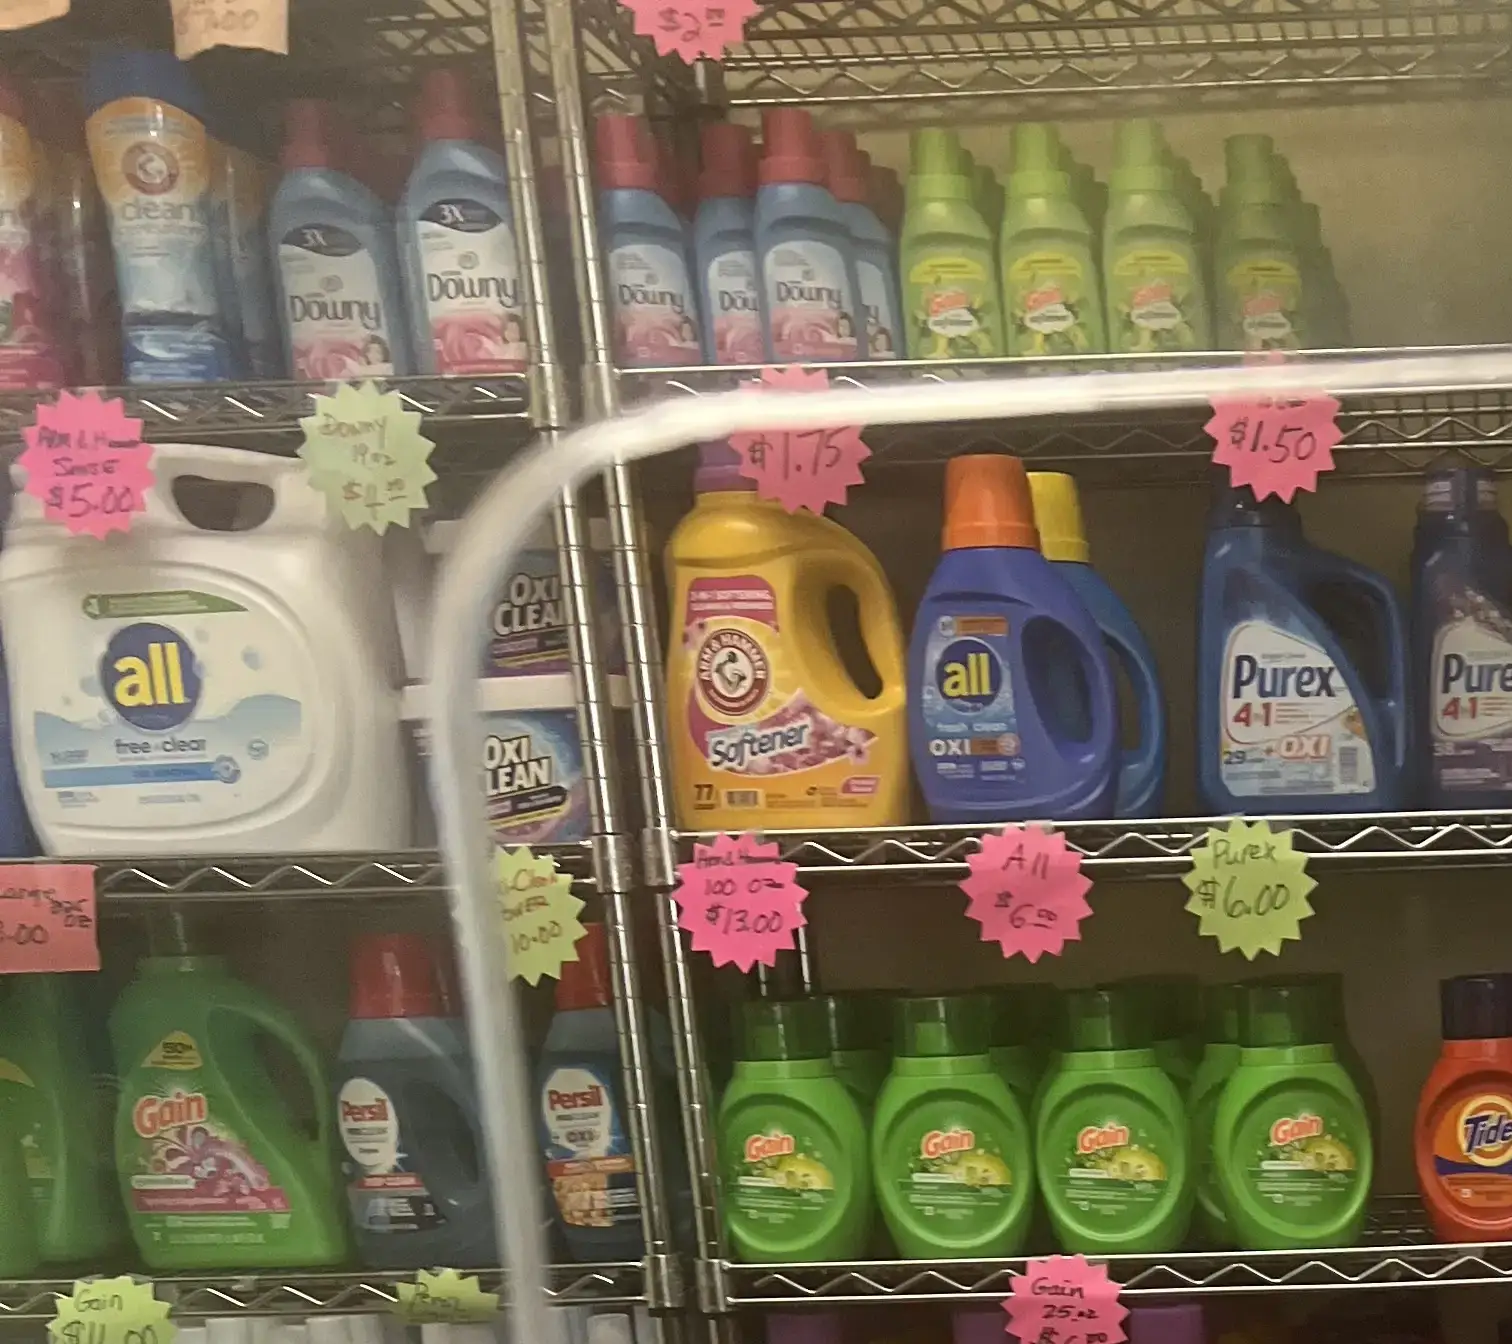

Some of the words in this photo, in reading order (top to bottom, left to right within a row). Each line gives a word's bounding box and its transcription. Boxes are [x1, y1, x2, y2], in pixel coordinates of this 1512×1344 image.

[440, 203, 465, 223] 3X
[426, 273, 520, 308] Downy
[618, 284, 685, 315] Downy
[719, 290, 760, 312] Dow
[776, 281, 842, 310] Downy
[288, 295, 381, 330] Downy
[747, 425, 851, 481] $1.75
[1228, 416, 1318, 464] $1.50
[509, 573, 560, 601] OXI
[493, 601, 567, 635] CLEA
[113, 642, 189, 707] all
[942, 652, 993, 697] all
[1233, 654, 1337, 699] Purex
[115, 738, 152, 755] free
[483, 735, 530, 768] OXI
[710, 723, 809, 768] Softener
[929, 739, 972, 756] OXI
[484, 758, 553, 796] LEAN
[1213, 838, 1278, 869] Purex
[135, 1091, 206, 1137] Gain
[548, 1085, 603, 1111] Persil
[1077, 1124, 1130, 1154] Gain
[1269, 1115, 1323, 1146] Gain
[74, 1288, 124, 1313] Gain
